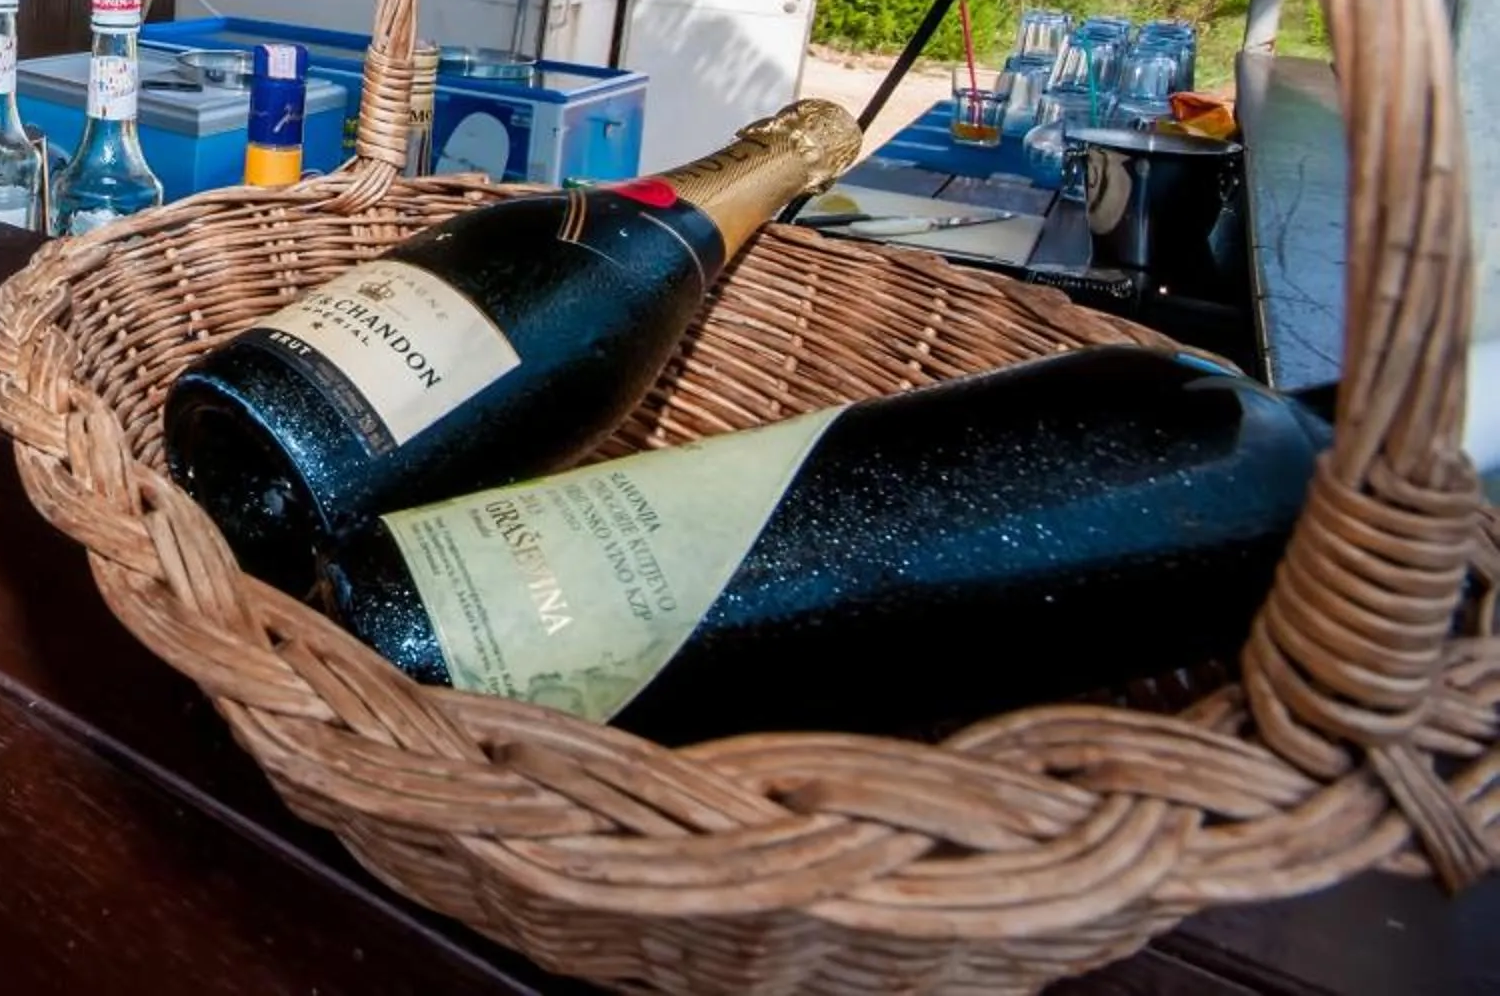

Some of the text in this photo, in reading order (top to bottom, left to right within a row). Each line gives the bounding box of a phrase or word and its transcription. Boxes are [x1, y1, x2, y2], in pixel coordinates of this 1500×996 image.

[269, 331, 313, 355] BRUT
[334, 298, 443, 390] CHANDON
[485, 499, 575, 637] GRAŠEVINA
